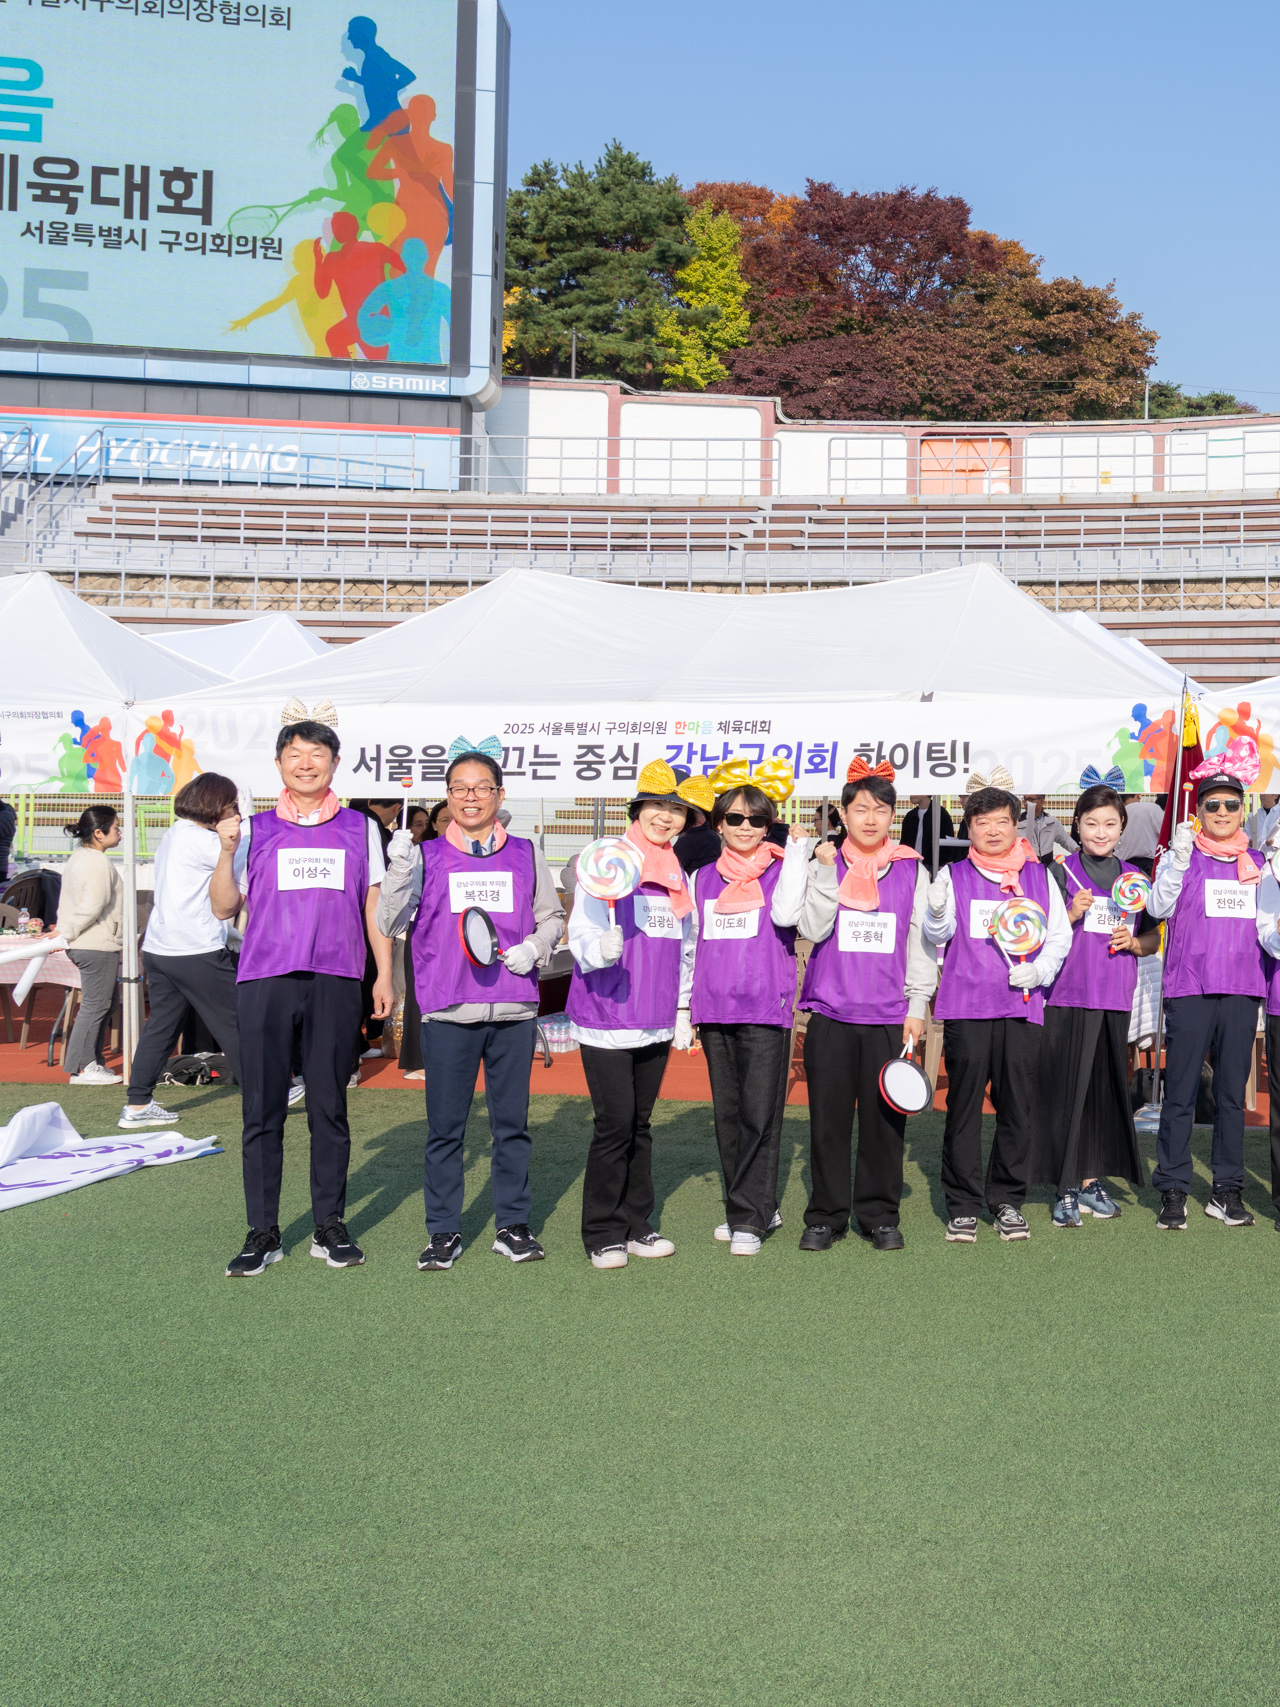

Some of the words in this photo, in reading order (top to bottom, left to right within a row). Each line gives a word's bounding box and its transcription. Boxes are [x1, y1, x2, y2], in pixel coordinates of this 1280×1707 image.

[20, 220, 147, 252] 서울특별시
[158, 229, 283, 261] 구의회의원
[371, 375, 447, 393] SAMIK
[70, 434, 301, 475] HYOCHANG
[503, 722, 535, 735] 2025
[538, 721, 601, 736] 서울특별시
[604, 720, 668, 736] 구의회의원
[674, 720, 714, 736] 한마음
[716, 719, 772, 736] 체육대회
[352, 743, 449, 782] 서울을
[501, 743, 562, 781] 끄는
[572, 742, 640, 782] 중심
[288, 857, 321, 865] 강남구의회
[322, 857, 336, 865] 의원
[293, 866, 331, 879] 이성수
[489, 880, 507, 888] 부의장
[464, 890, 500, 902] 복진경
[1212, 888, 1238, 896] 강남구의회
[1216, 898, 1246, 910] 전인수
[647, 915, 674, 928] 김광심
[715, 917, 746, 930] 이도희
[847, 920, 876, 928] 강남구의회
